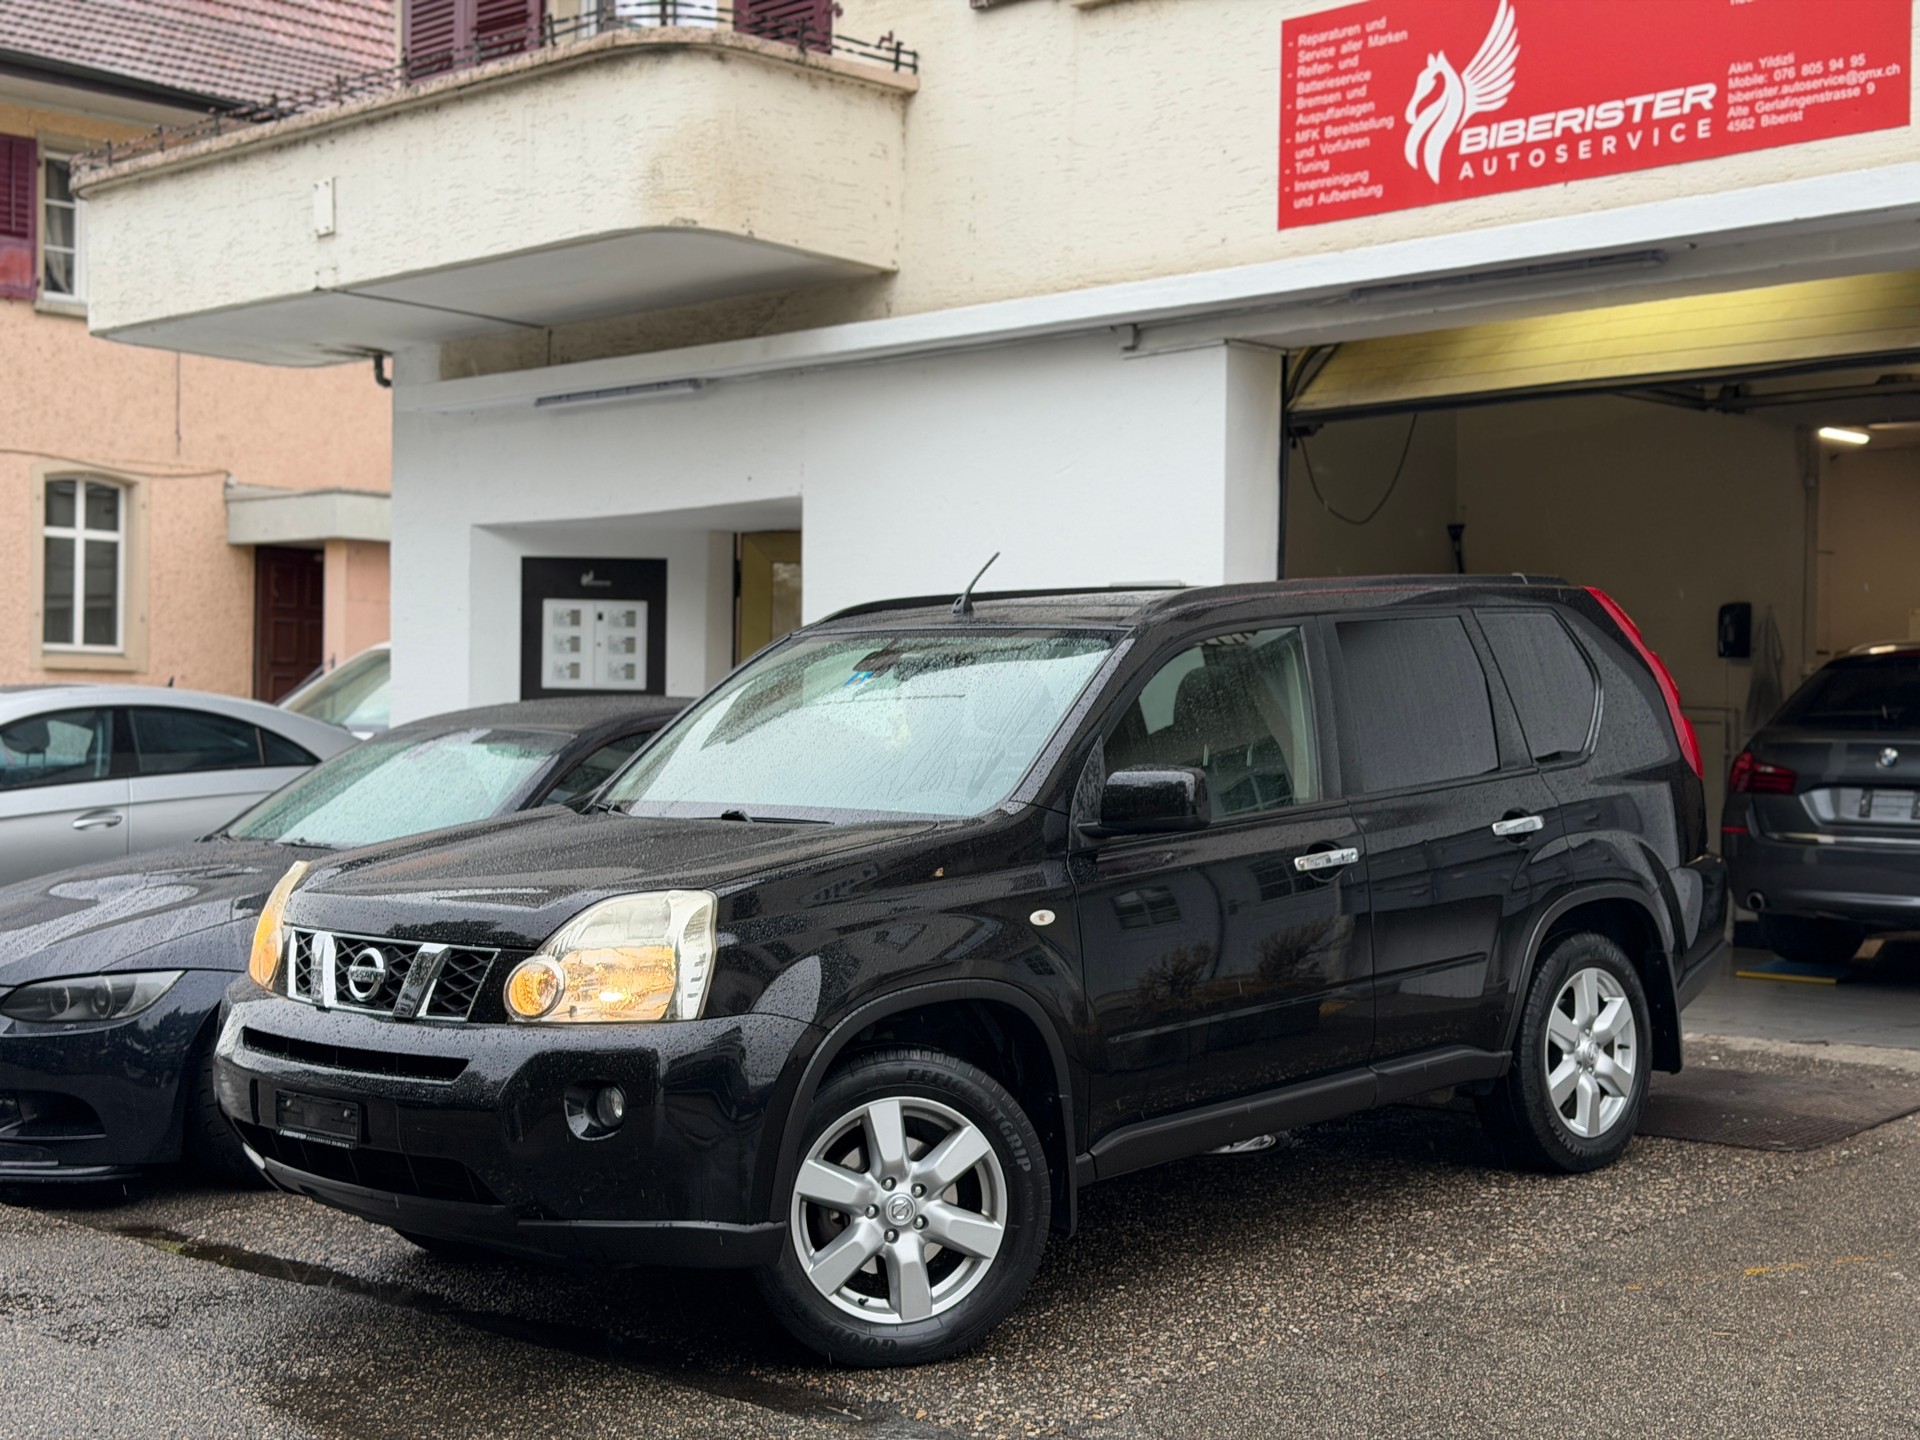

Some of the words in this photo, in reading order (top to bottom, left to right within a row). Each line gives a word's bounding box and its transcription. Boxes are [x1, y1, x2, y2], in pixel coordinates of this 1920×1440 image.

[1298, 24, 1361, 47] Reparaturen
[1366, 16, 1387, 32] und
[1298, 46, 1336, 64] Service
[1341, 40, 1364, 55] aller
[1368, 30, 1408, 48] Marken
[1338, 55, 1359, 70] und
[1728, 62, 1754, 75] Akin
[1728, 73, 1768, 89] Mobile:
[1773, 66, 1796, 81] 076
[1801, 61, 1823, 77] 805
[1829, 57, 1844, 72] 94
[1850, 53, 1866, 68] 95
[1296, 69, 1372, 95] Batterieservice
[1728, 63, 1901, 104] biberister.autoservice@gmx.ch
[1296, 91, 1342, 110] Bremsen
[1346, 84, 1367, 100] und
[1727, 105, 1750, 119] Alte
[1755, 86, 1861, 114] Gerlafingenstrasse
[1866, 81, 1876, 95] 9
[1296, 101, 1375, 126] Auspuffanlagen
[1459, 83, 1716, 155] BIBERISTER
[1726, 117, 1755, 132] 4562
[1761, 110, 1804, 128] Biberist
[1295, 128, 1320, 144] MFK
[1324, 115, 1395, 139] Bereitstellung
[1295, 145, 1315, 160] und
[1459, 118, 1711, 181] AUTOSERVICE
[1295, 159, 1330, 174] Tuning
[1294, 169, 1369, 192] Innenreinigung
[1293, 194, 1314, 209] und
[1317, 184, 1384, 205] Aufbereitung
